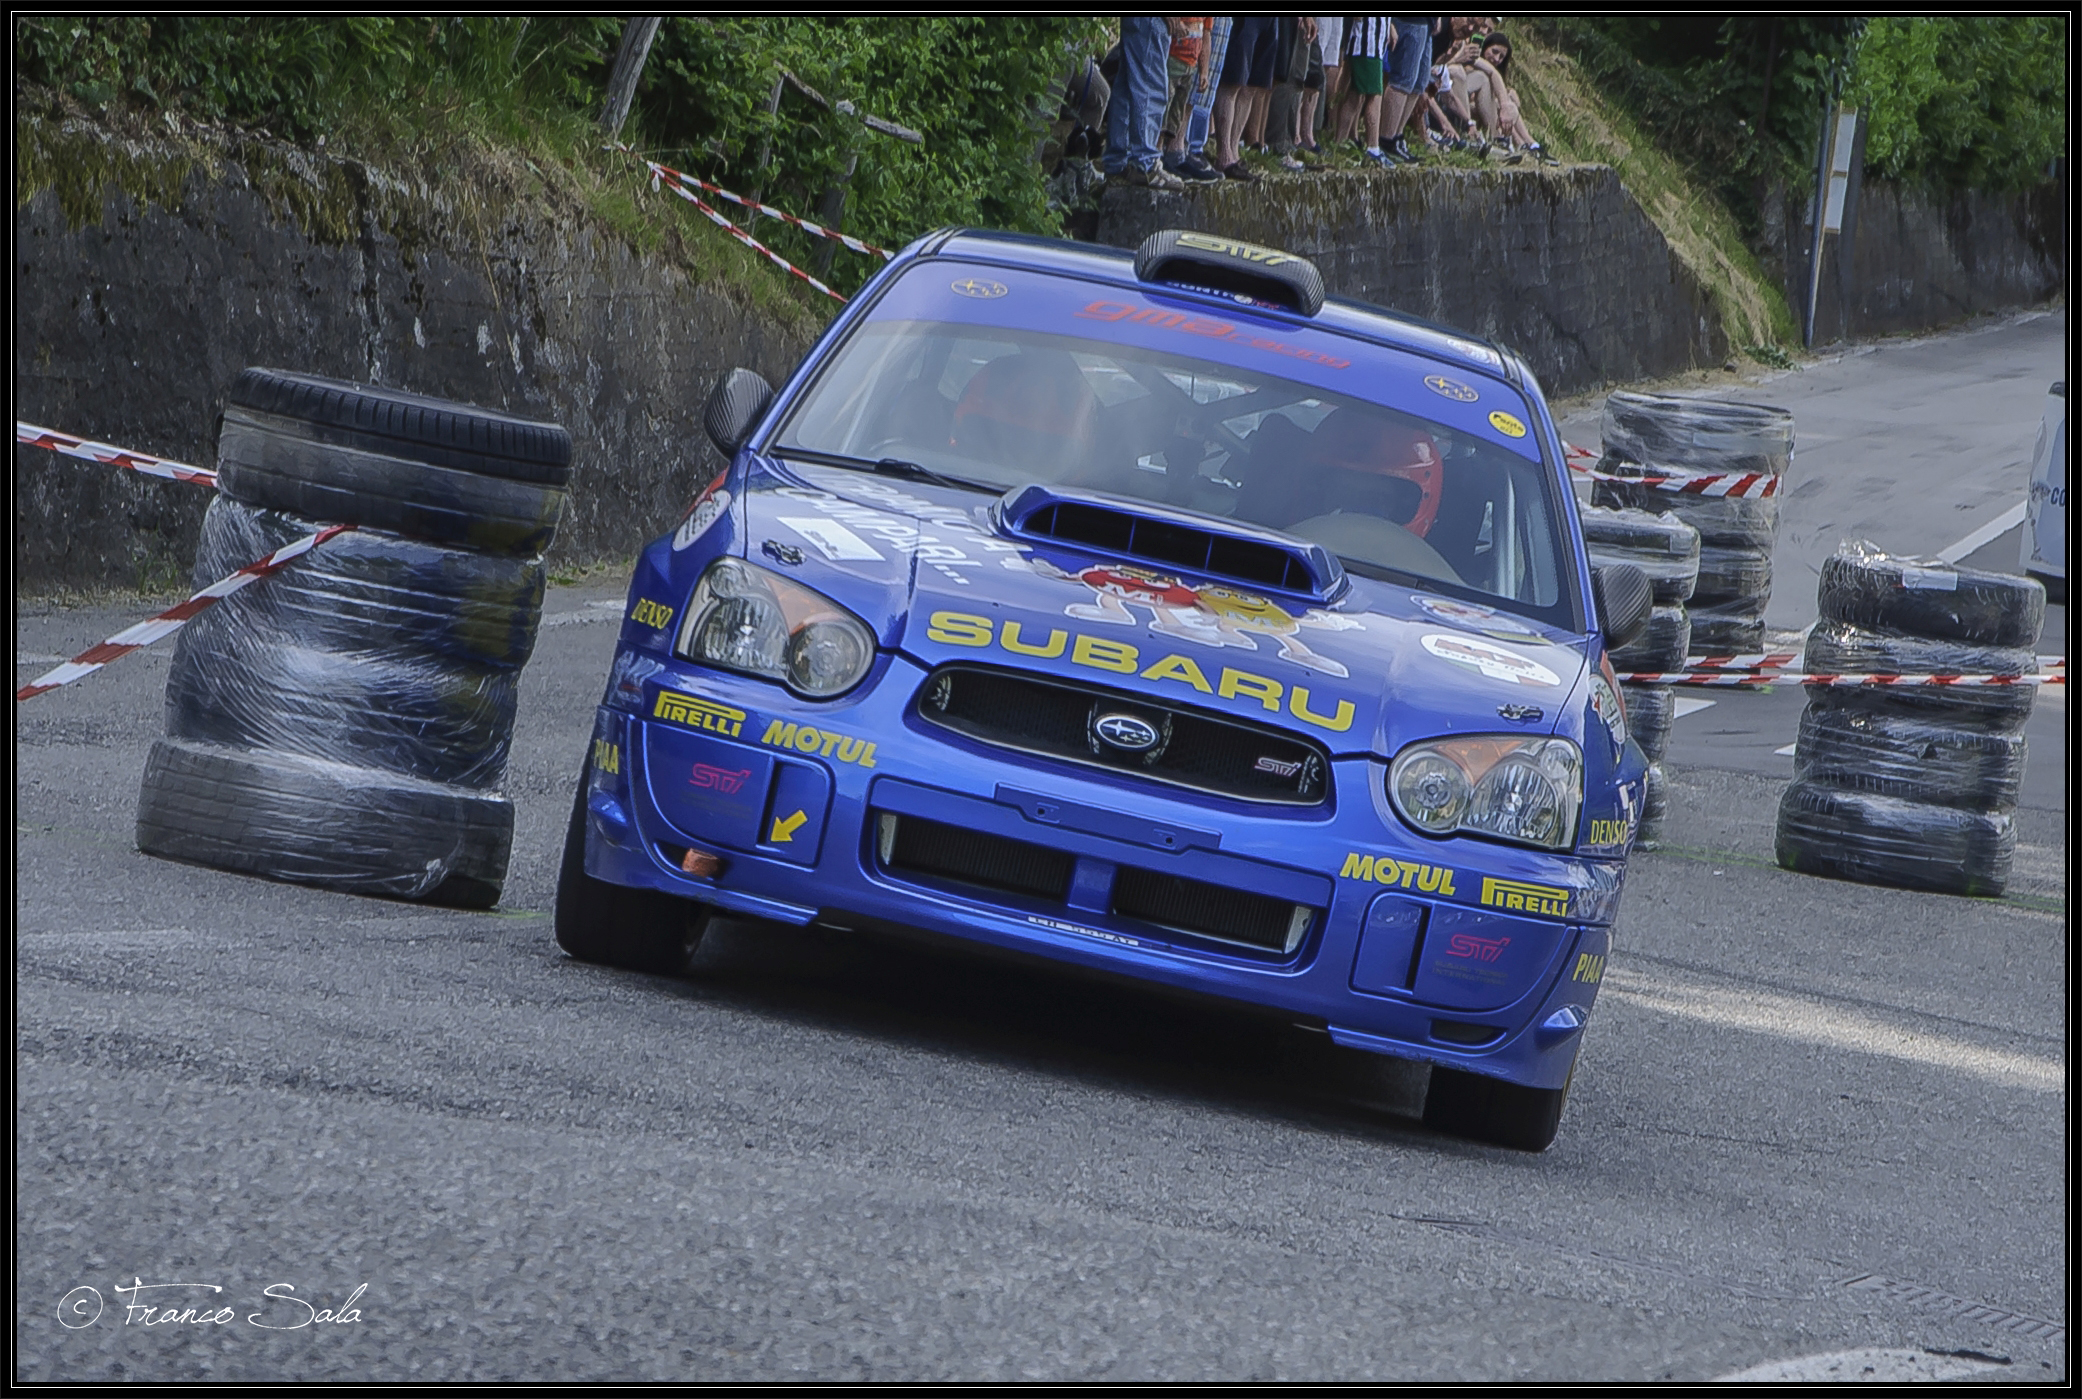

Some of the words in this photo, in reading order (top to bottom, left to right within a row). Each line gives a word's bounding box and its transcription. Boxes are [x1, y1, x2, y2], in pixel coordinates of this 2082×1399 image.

[631, 597, 674, 630] DENSO
[926, 610, 1357, 733] SUBARU
[653, 690, 747, 738] PIRELLI
[761, 719, 878, 768] MOTUL
[1590, 820, 1627, 845] DENSO
[1340, 852, 1456, 896] MOTUL
[1480, 876, 1569, 917] PIRELLI
[1572, 953, 1605, 984] PIAA
